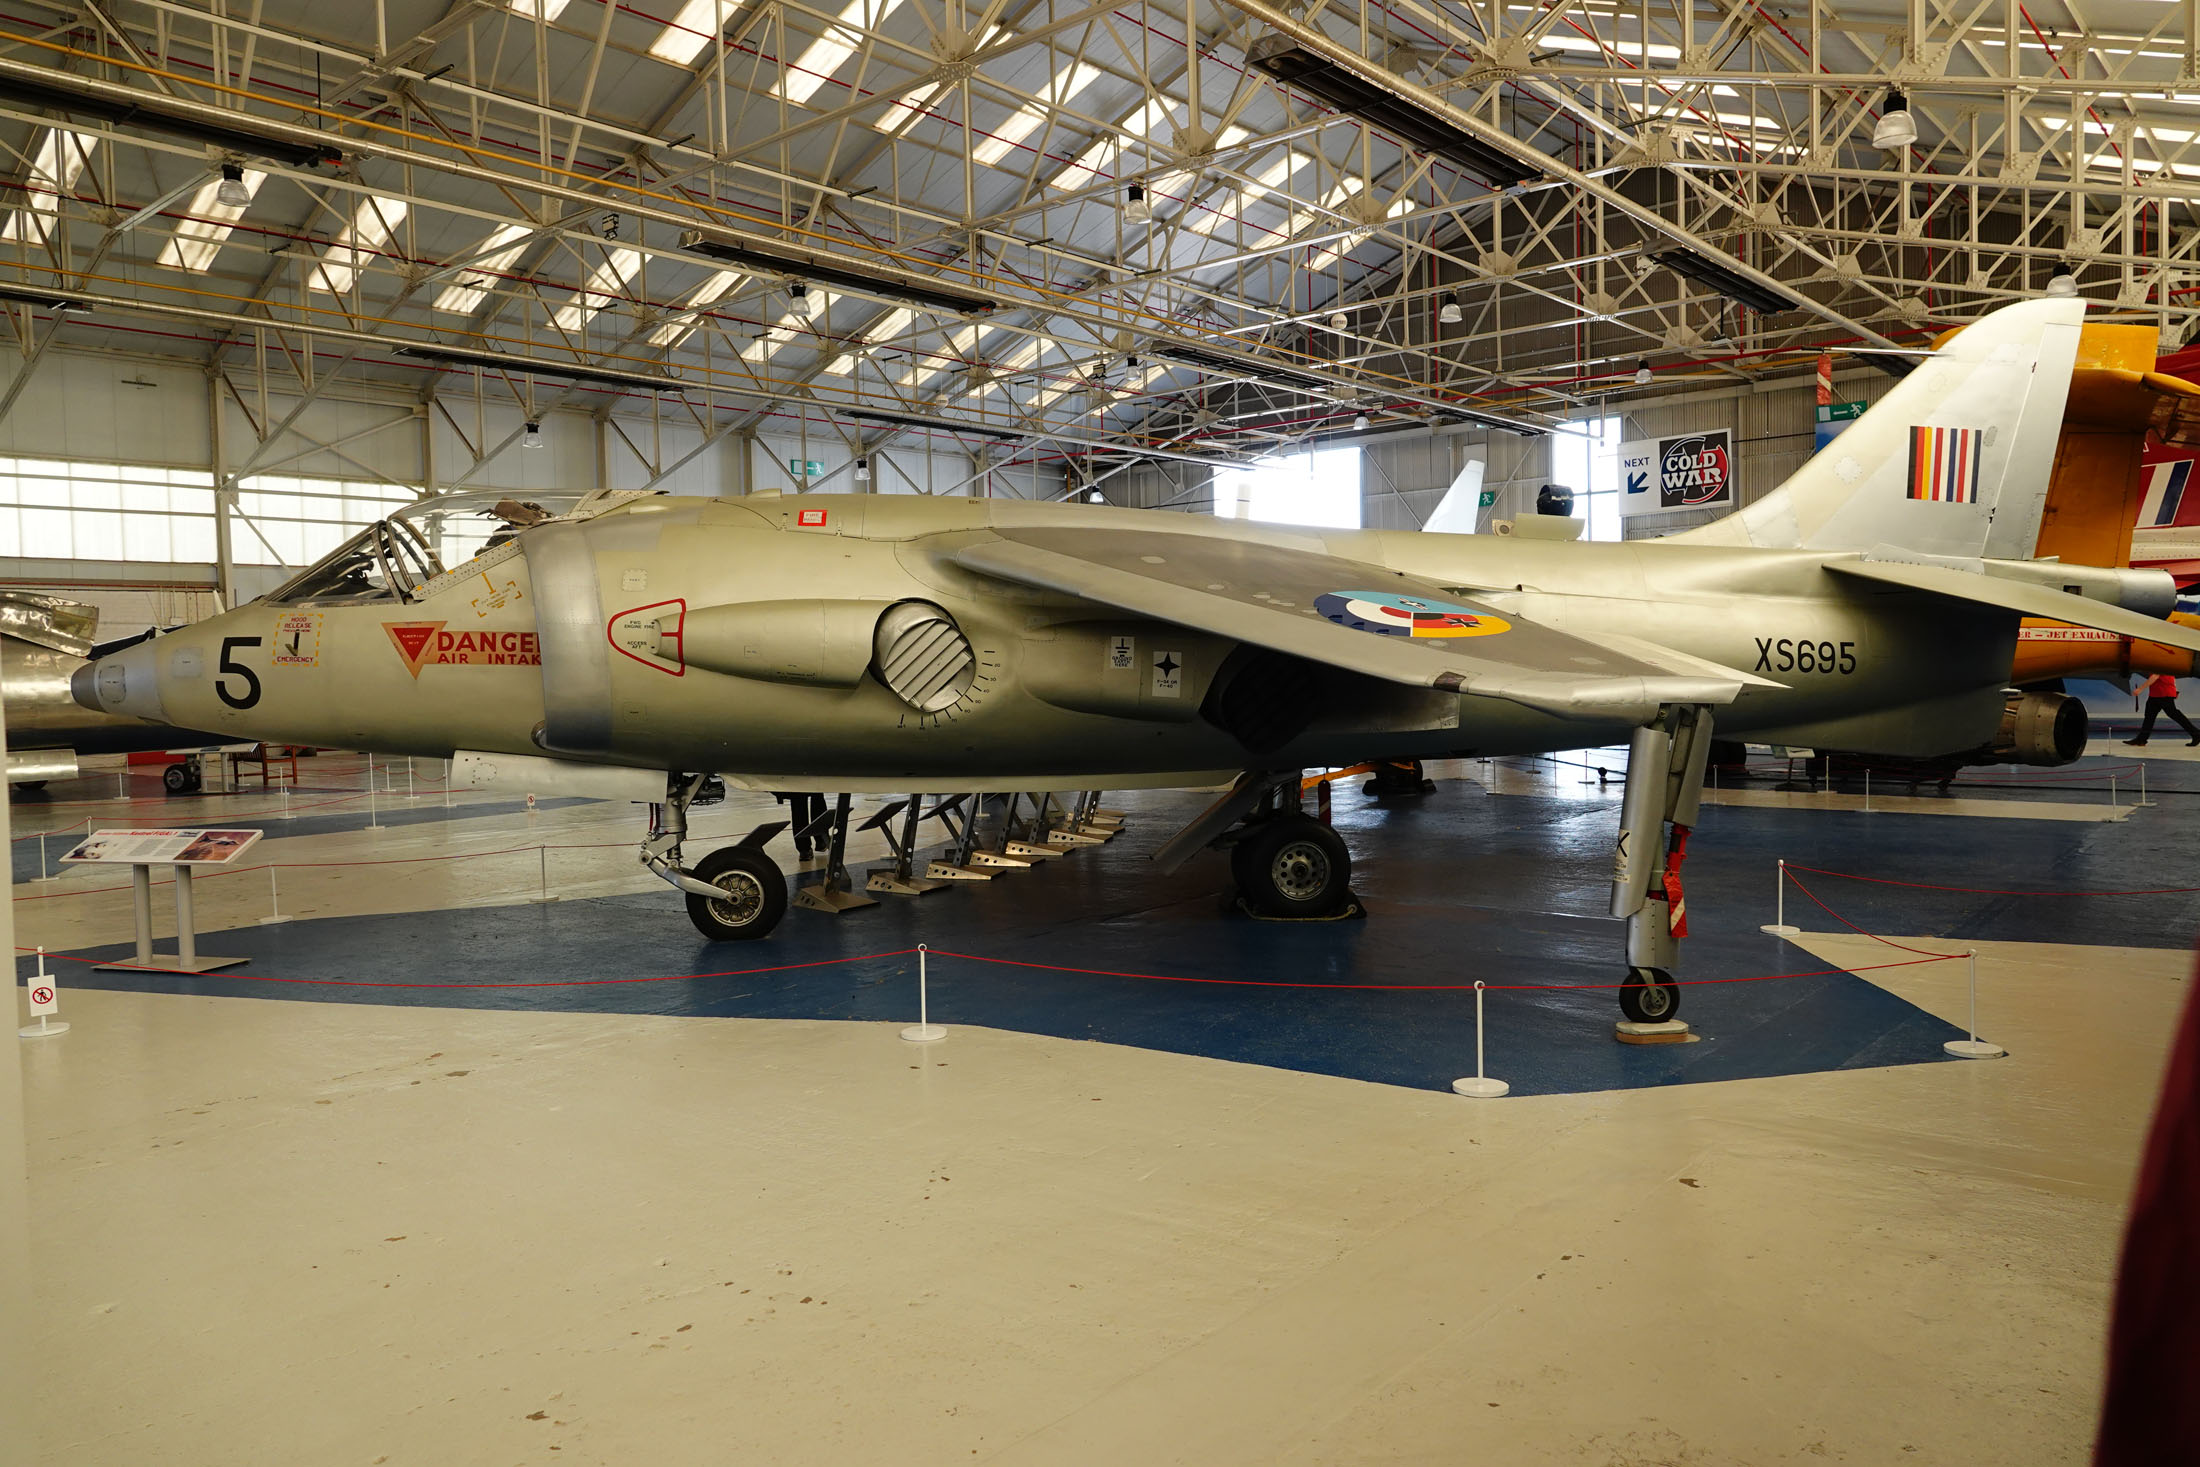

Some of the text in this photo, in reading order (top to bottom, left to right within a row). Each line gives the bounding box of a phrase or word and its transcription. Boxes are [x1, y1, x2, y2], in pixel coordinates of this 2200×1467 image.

[1624, 456, 1650, 468] NEXT
[1666, 452, 1717, 472] COLD
[1662, 467, 1722, 489] WAR
[2047, 631, 2068, 639] JET
[437, 653, 469, 664] AIR
[488, 653, 542, 665] INTAK
[1754, 637, 1856, 675] XS695
[215, 636, 262, 710] 5
